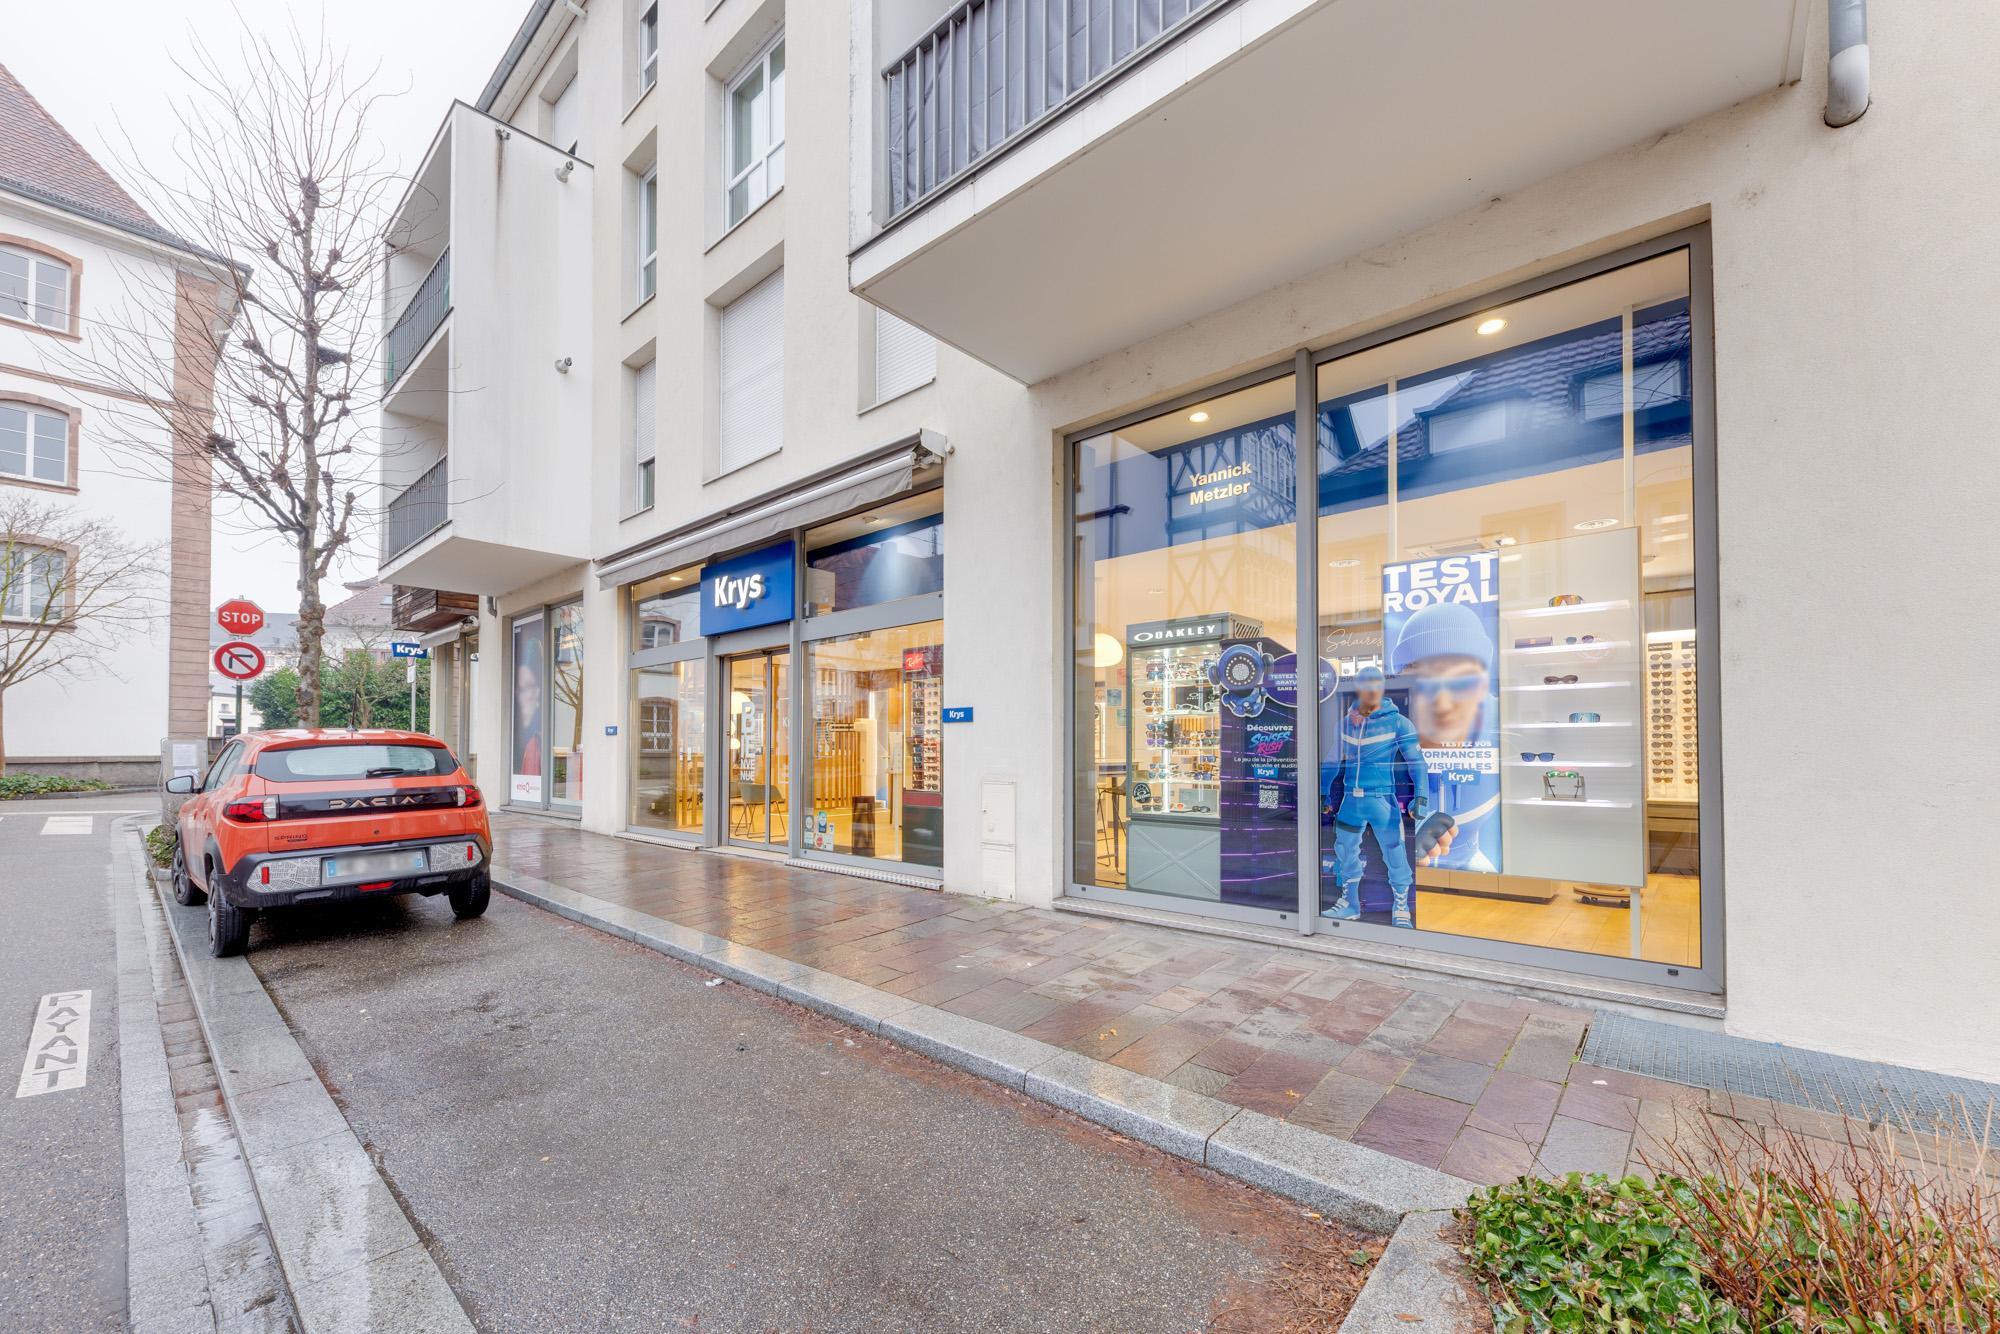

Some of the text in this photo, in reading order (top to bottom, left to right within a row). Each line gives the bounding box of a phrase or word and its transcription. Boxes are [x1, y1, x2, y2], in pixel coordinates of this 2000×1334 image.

[1189, 461, 1252, 487] Yannick
[1189, 482, 1251, 506] Metzler
[1383, 551, 1499, 592] TEST
[714, 574, 765, 609] Krys
[1383, 580, 1499, 613] ROYAL
[222, 611, 260, 625] STOP
[1155, 625, 1215, 639] OAKLEY
[1326, 628, 1384, 653] Solaires
[396, 644, 424, 655] Krys
[949, 710, 965, 719] Krys
[1249, 732, 1291, 748] SENSES
[1257, 741, 1285, 755] RUSH
[1424, 751, 1492, 759] ORMANCES
[1257, 768, 1275, 776] Krys
[1427, 762, 1492, 770] VISUELLES
[1448, 772, 1475, 783] Krys
[328, 795, 417, 809] DACIA
[31, 993, 84, 1089] PAYANT
